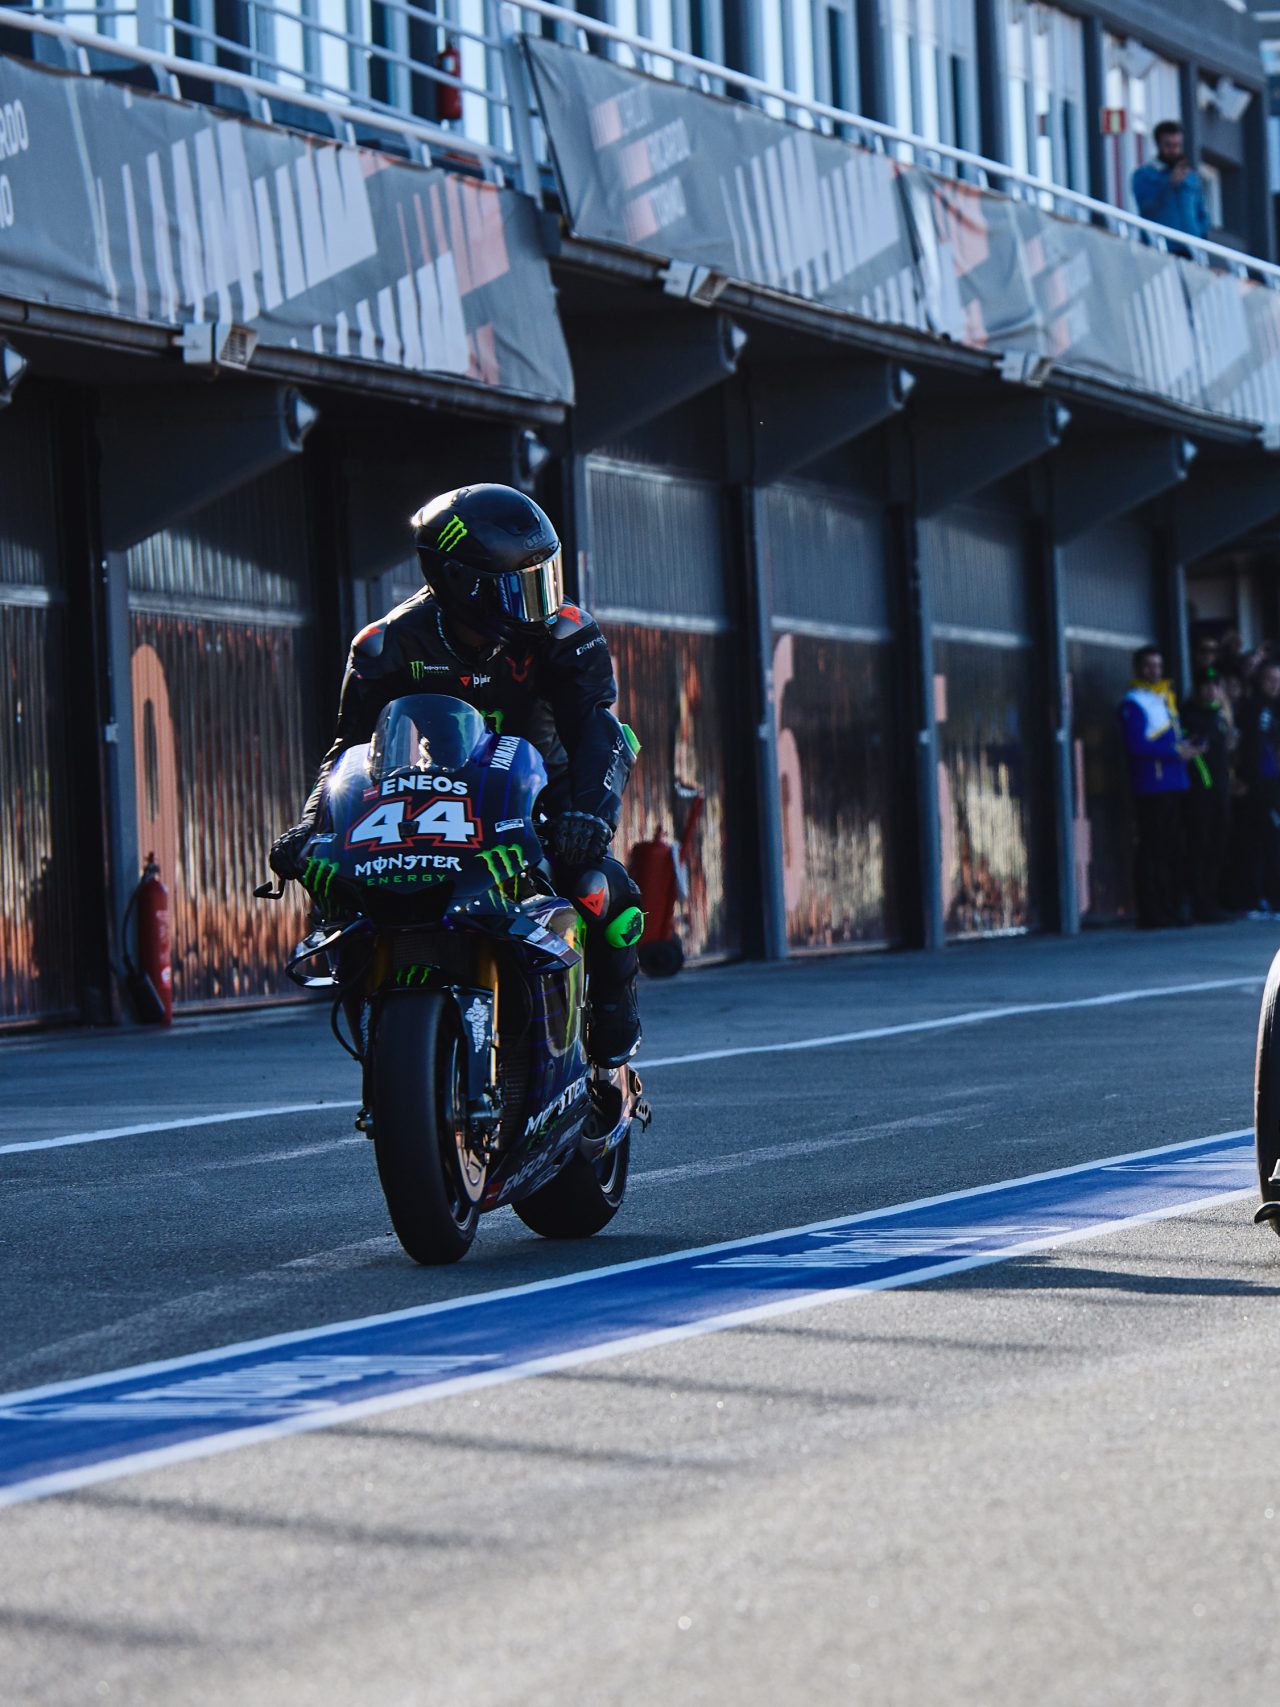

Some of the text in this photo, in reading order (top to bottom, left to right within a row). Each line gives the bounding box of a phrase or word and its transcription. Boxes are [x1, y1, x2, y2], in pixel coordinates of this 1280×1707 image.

[489, 735, 521, 771] YAMAHA
[381, 775, 468, 796] ENEOS
[347, 799, 480, 847] 44
[354, 853, 463, 877] MONSTER
[366, 874, 447, 887] ENERGY
